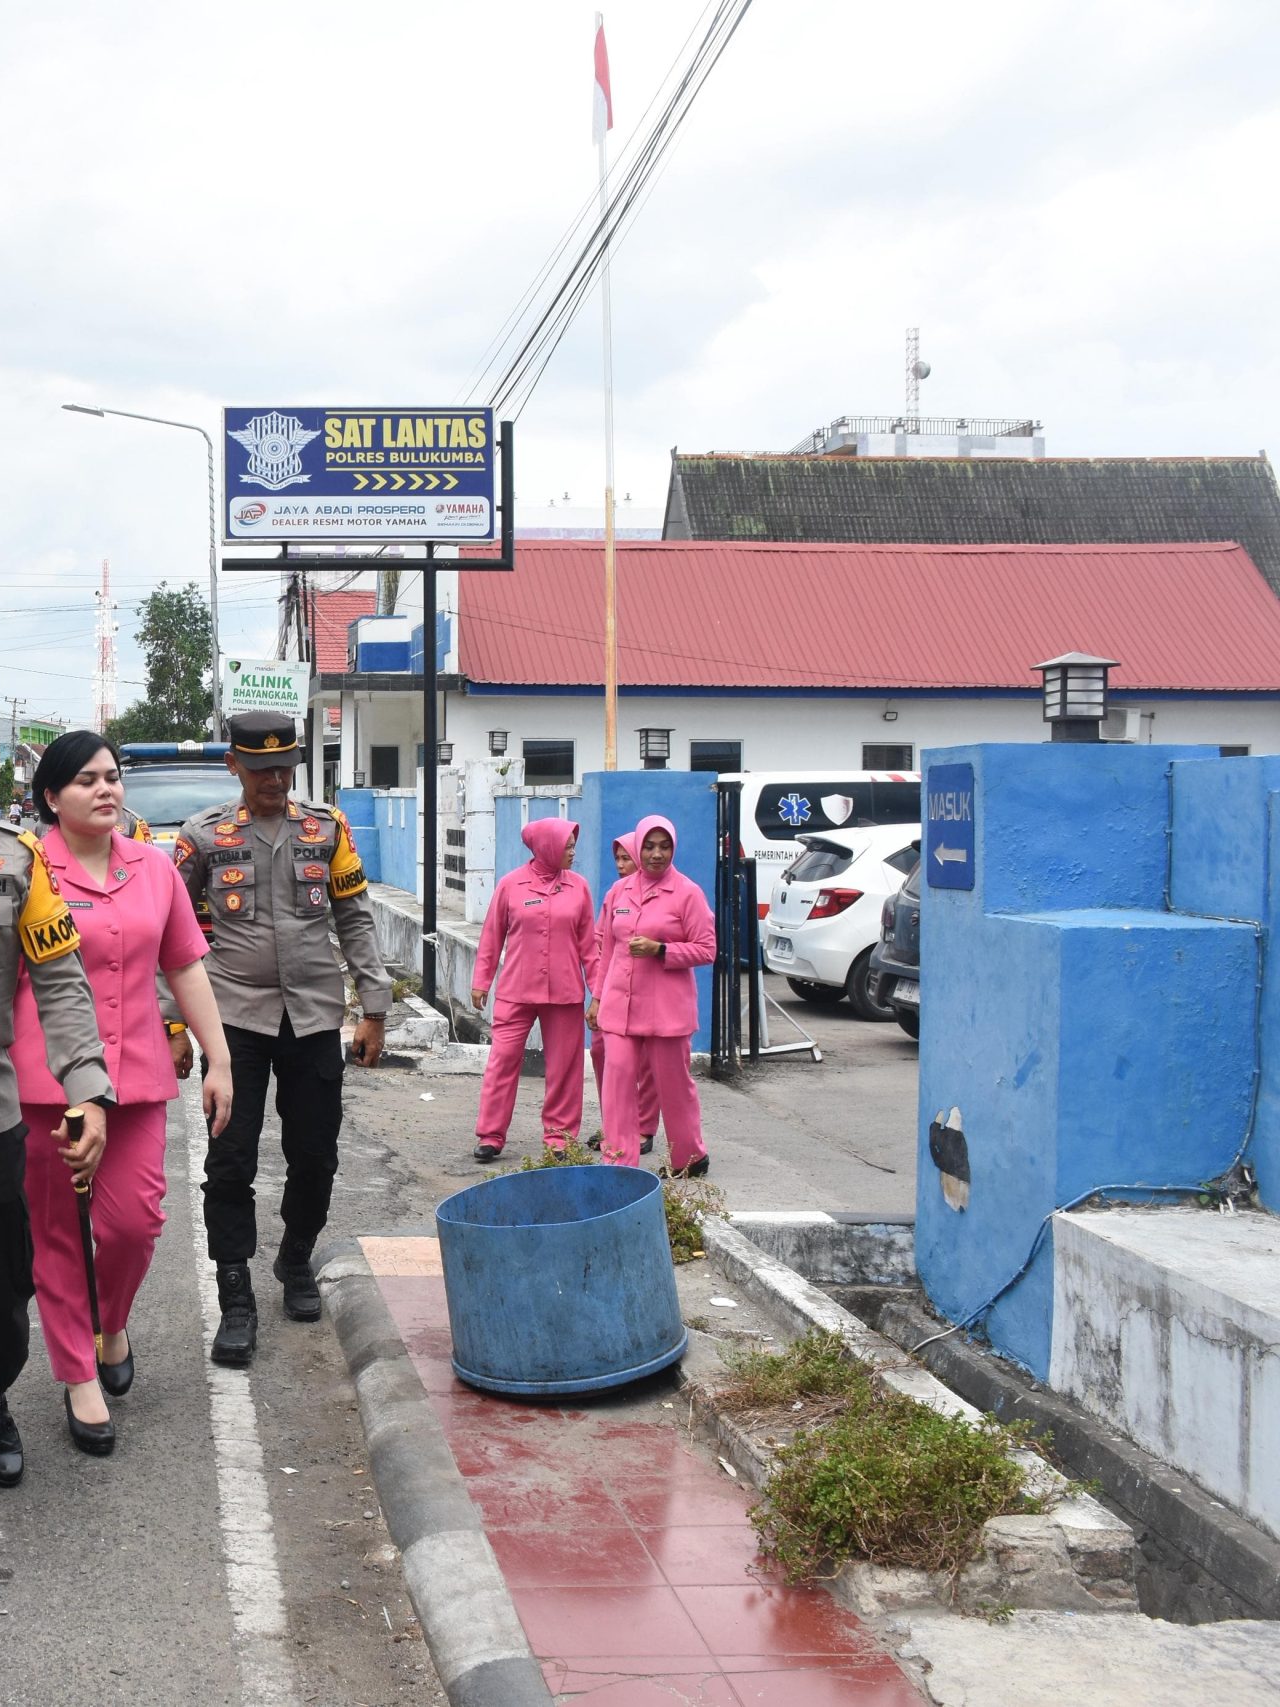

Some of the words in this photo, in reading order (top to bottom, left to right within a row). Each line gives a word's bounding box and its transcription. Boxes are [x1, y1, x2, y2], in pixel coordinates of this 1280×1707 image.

[324, 418, 376, 448] SAT
[383, 418, 486, 448] LANTAS
[325, 452, 384, 463] POLRES
[389, 452, 485, 463] BULUKUMBA
[273, 505, 310, 515] JAYA
[358, 505, 426, 515] PROSPERO
[446, 504, 485, 513] YAMAHA
[272, 518, 309, 526] DEALER
[313, 518, 344, 526] RESMI
[347, 518, 383, 526] MOTOR
[385, 518, 427, 526] YAMAHA
[240, 674, 293, 689] KLINIK
[233, 688, 298, 701] BHAYANGKARA
[232, 698, 257, 706] POLRES
[258, 700, 298, 708] BULUKUMBA
[928, 792, 971, 821] MASUK
[293, 848, 330, 859] POLRI
[754, 850, 793, 860] PEMERINTAH
